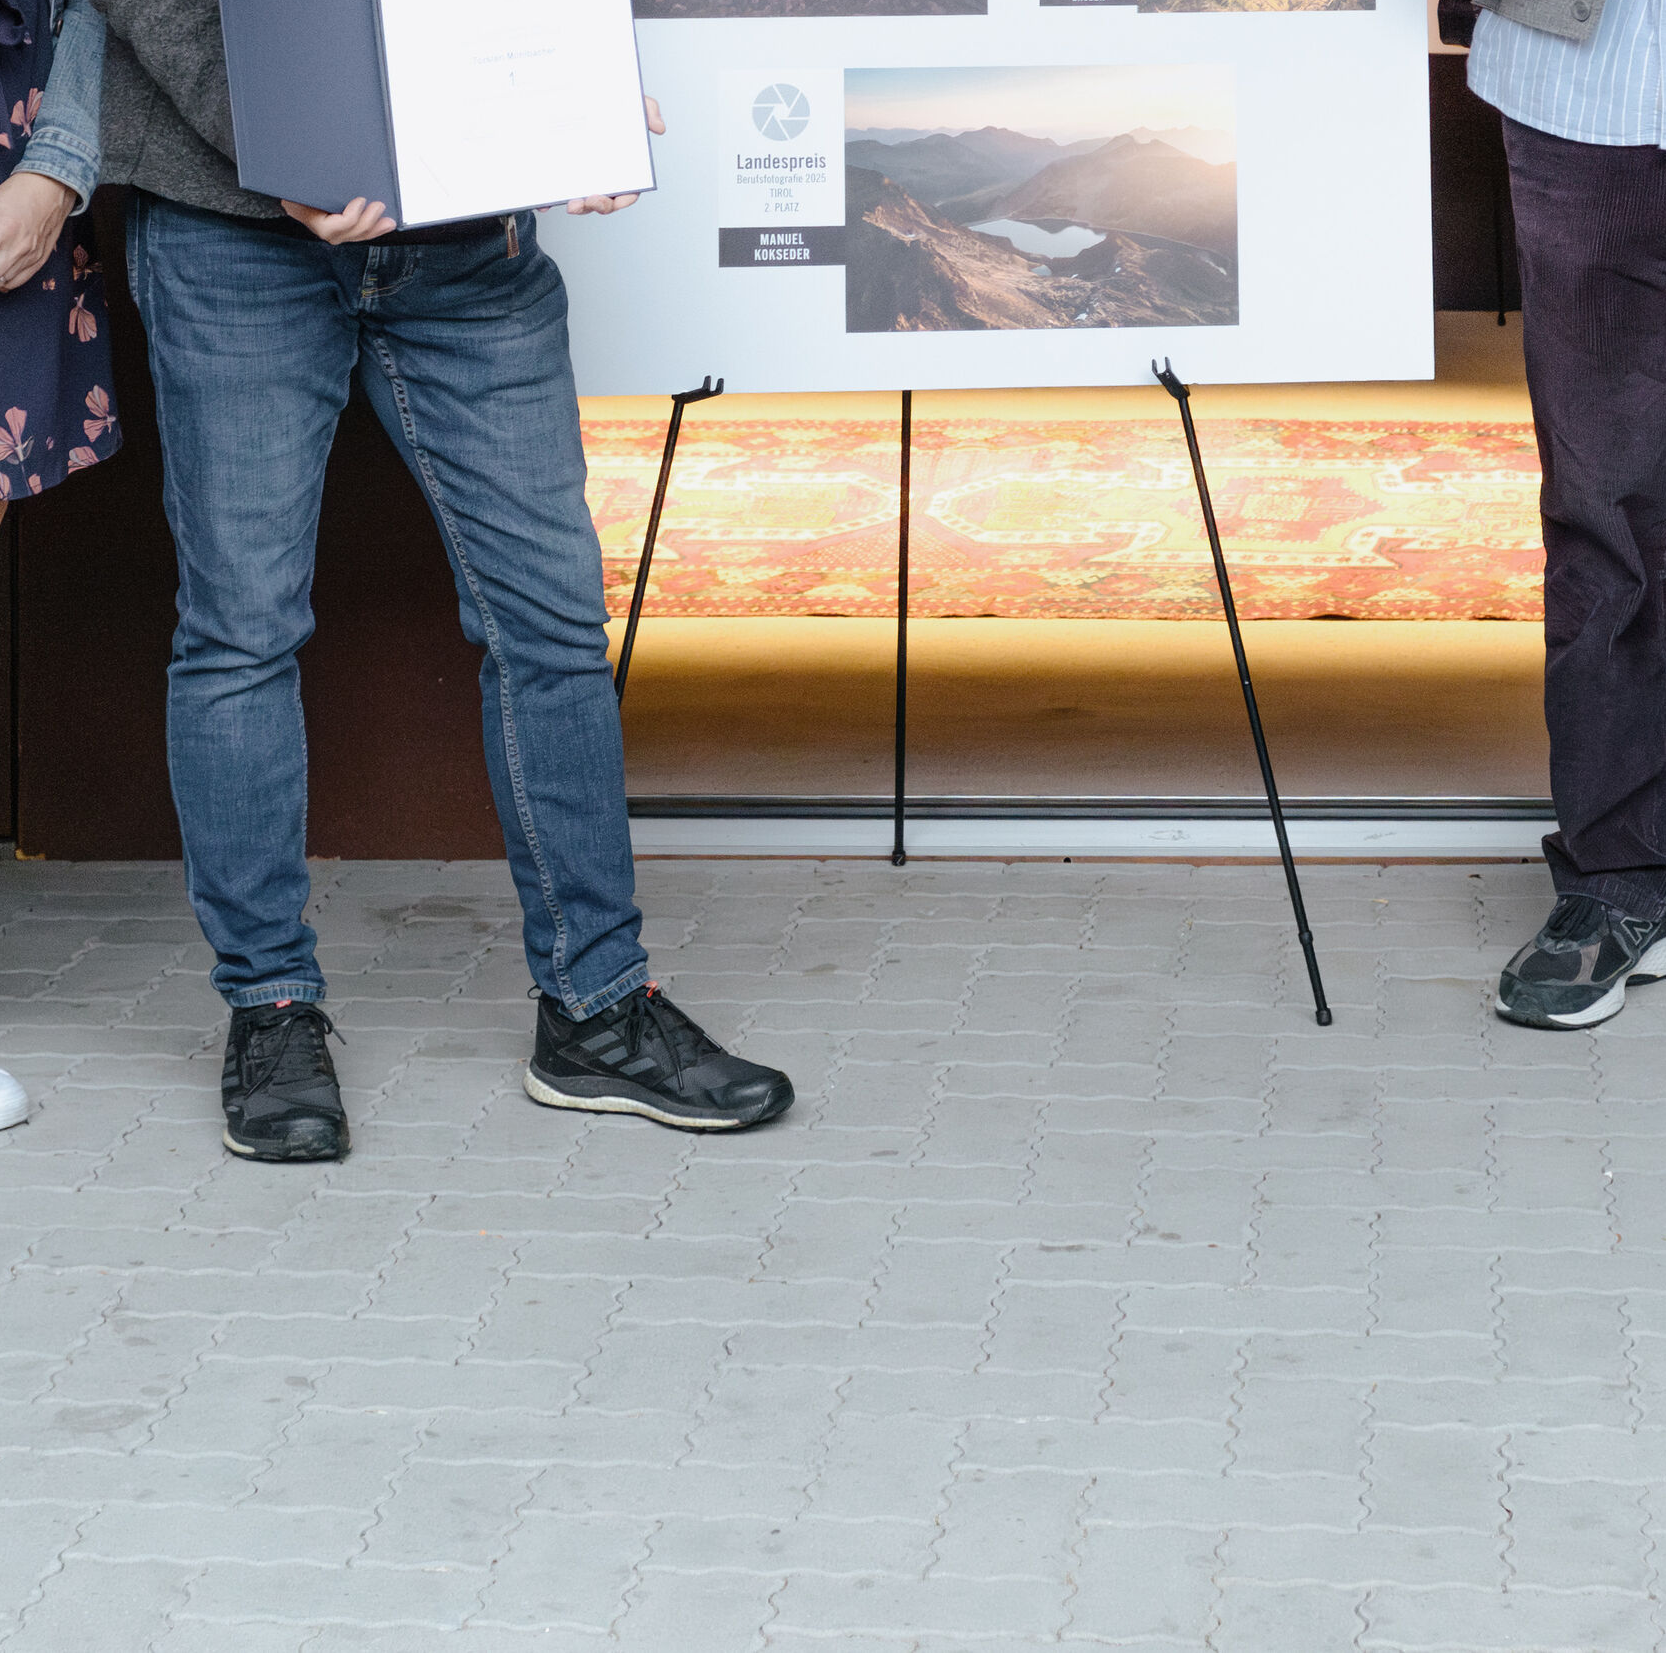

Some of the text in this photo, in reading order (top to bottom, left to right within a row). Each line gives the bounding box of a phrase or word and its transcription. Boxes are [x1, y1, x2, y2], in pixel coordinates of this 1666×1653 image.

[736, 153, 826, 172] Landespreis
[736, 173, 826, 186] Berufsfotografie 2025
[769, 188, 794, 198] TIROL
[775, 202, 799, 213] PLATZ
[760, 232, 804, 246] MANUEL
[754, 248, 810, 262] KOKSEDER
